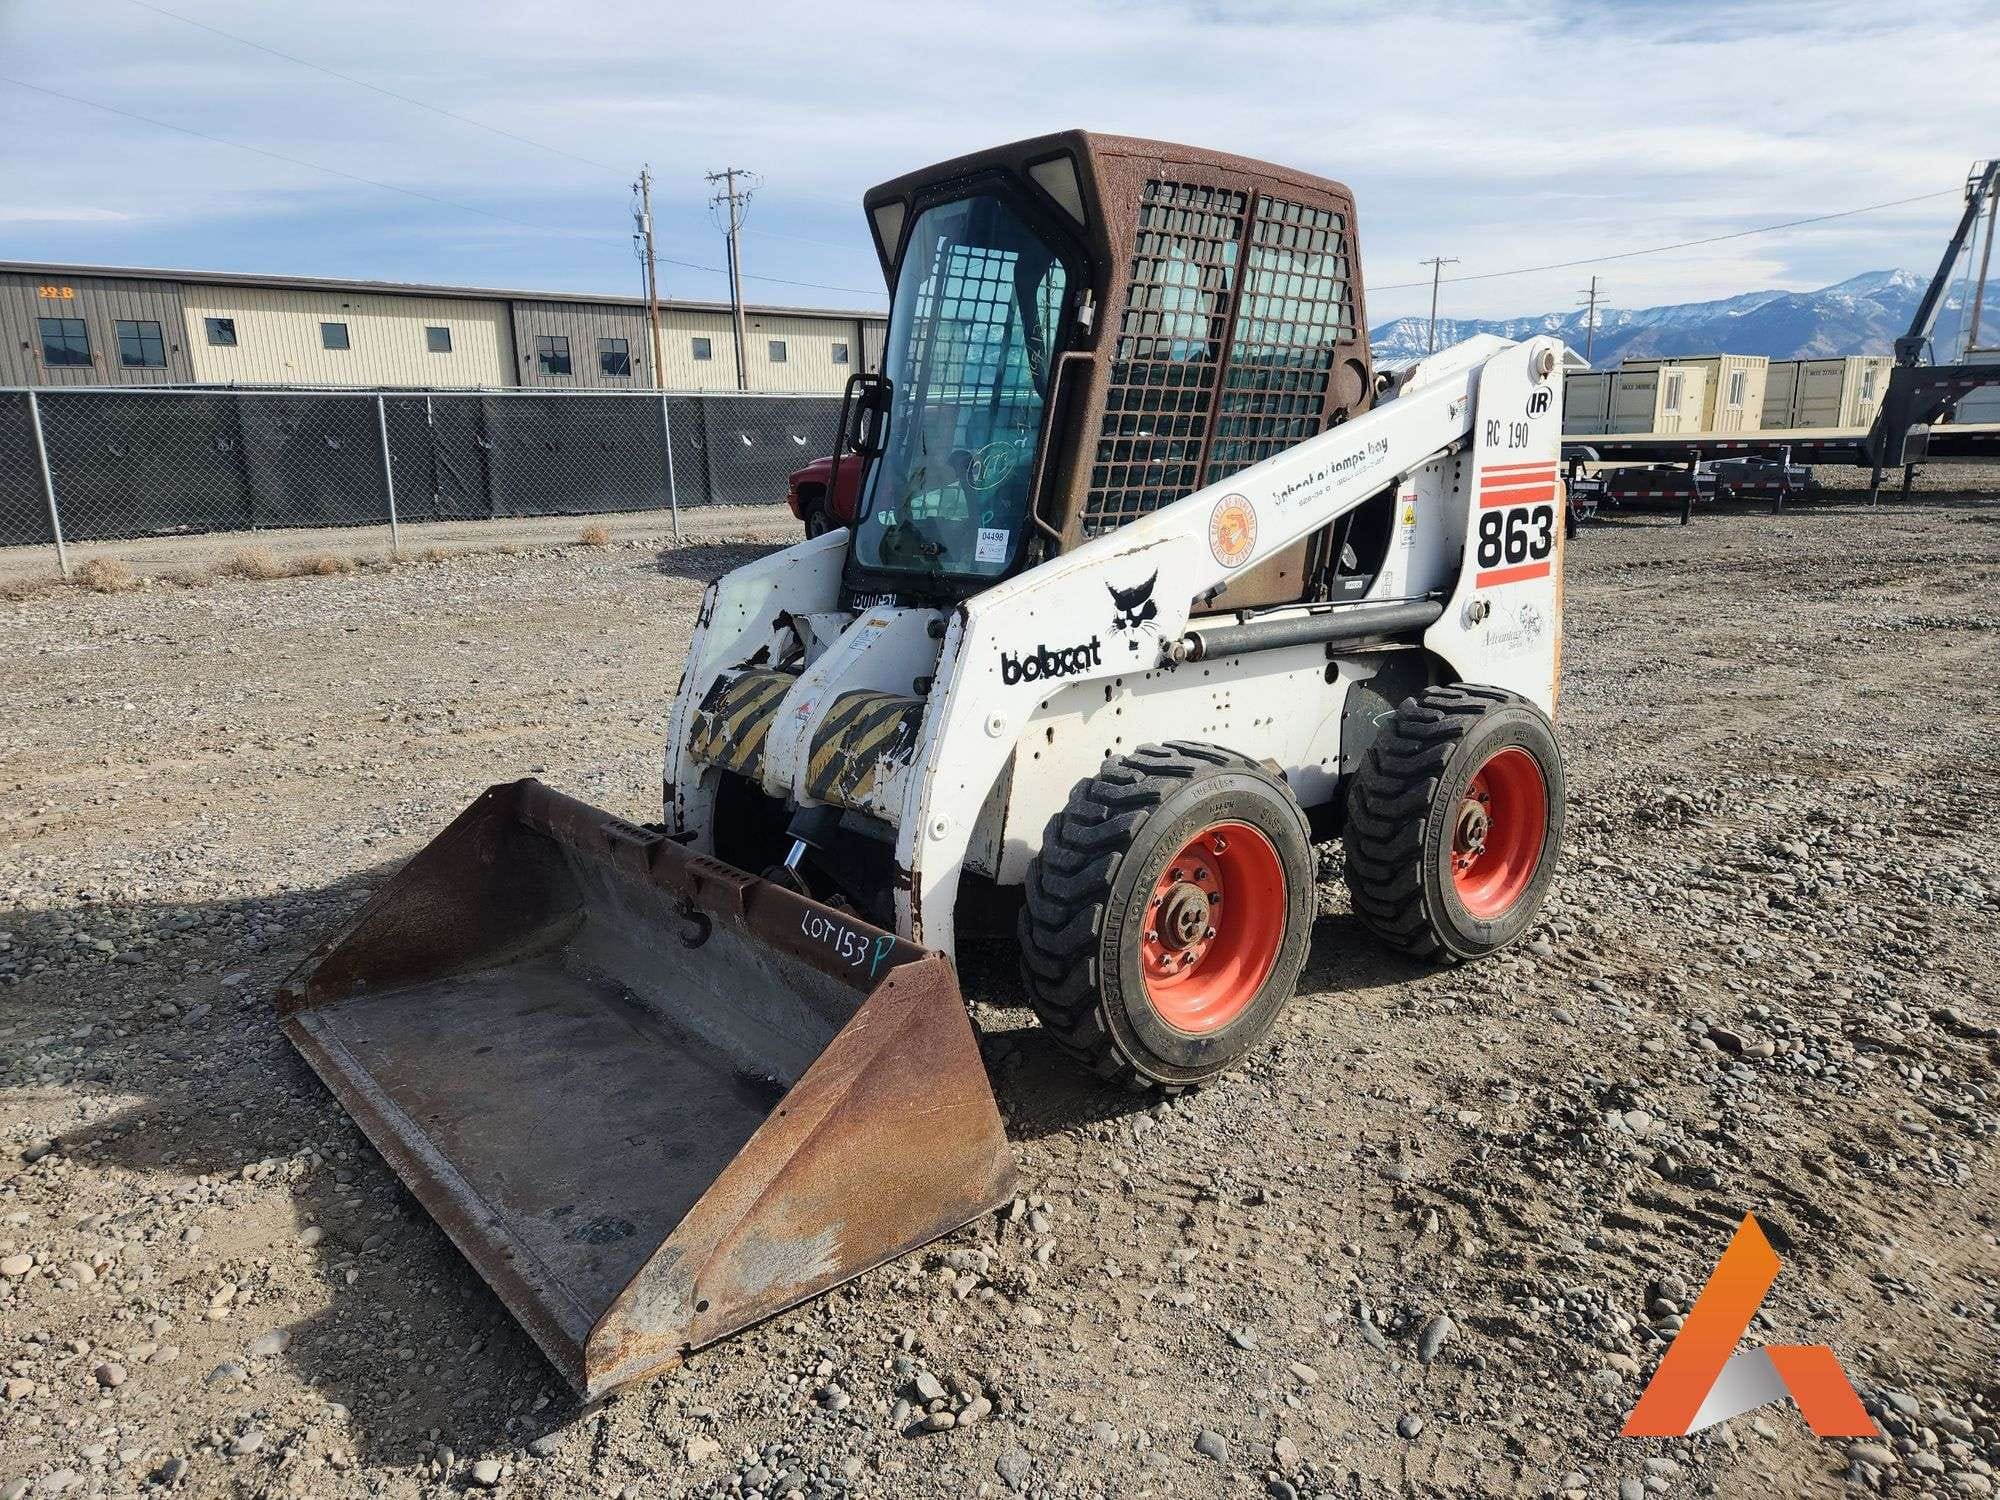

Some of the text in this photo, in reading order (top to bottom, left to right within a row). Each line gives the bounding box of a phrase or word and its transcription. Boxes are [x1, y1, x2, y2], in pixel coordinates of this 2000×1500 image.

[1530, 392, 1549, 414] IR
[1486, 419, 1529, 449] RC 190
[982, 531, 1005, 542] 04498
[1477, 504, 1554, 569] 863
[1001, 634, 1102, 686] bobcat
[870, 934, 896, 978] P
